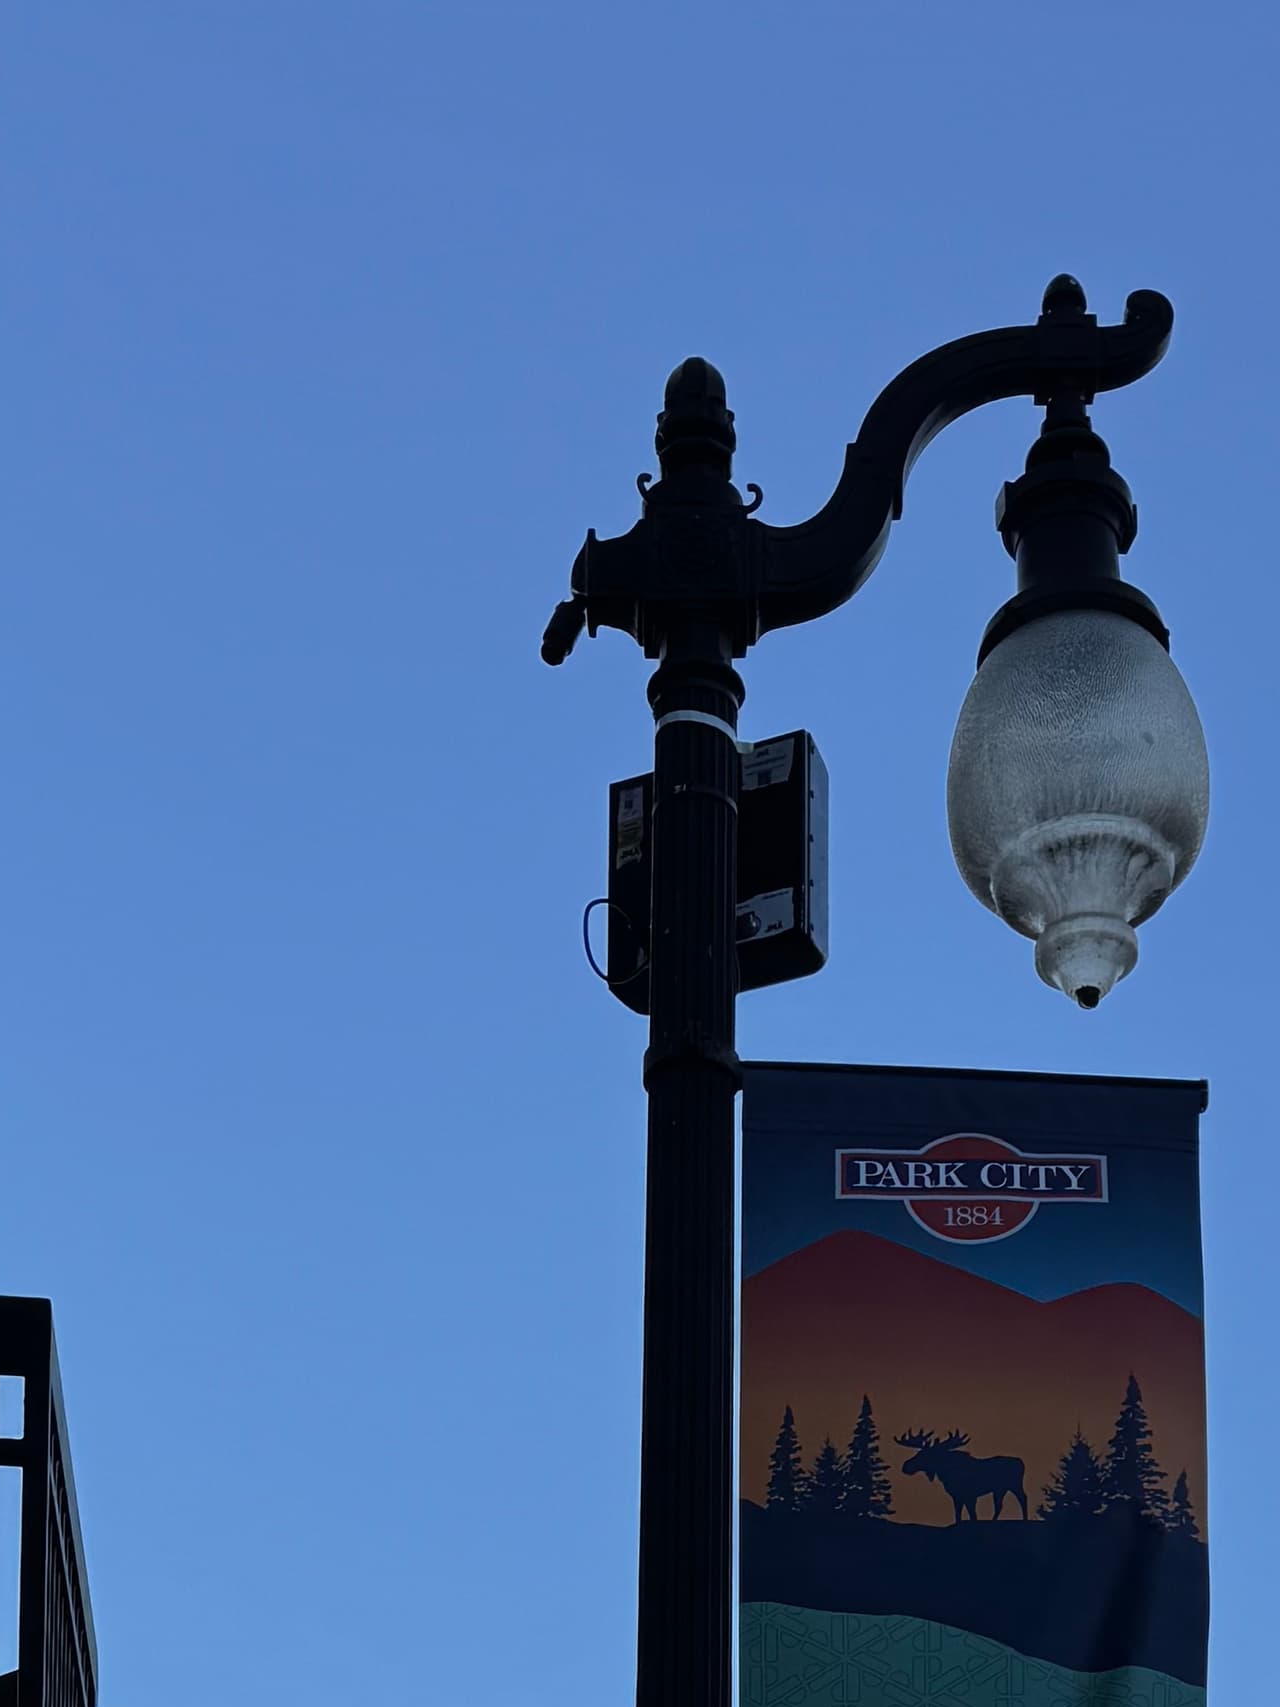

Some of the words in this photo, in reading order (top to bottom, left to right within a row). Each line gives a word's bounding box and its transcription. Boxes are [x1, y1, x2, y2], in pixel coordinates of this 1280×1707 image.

[852, 1160, 969, 1189] PARK
[980, 1162, 1091, 1191] CITY
[943, 1206, 1005, 1227] 1884
